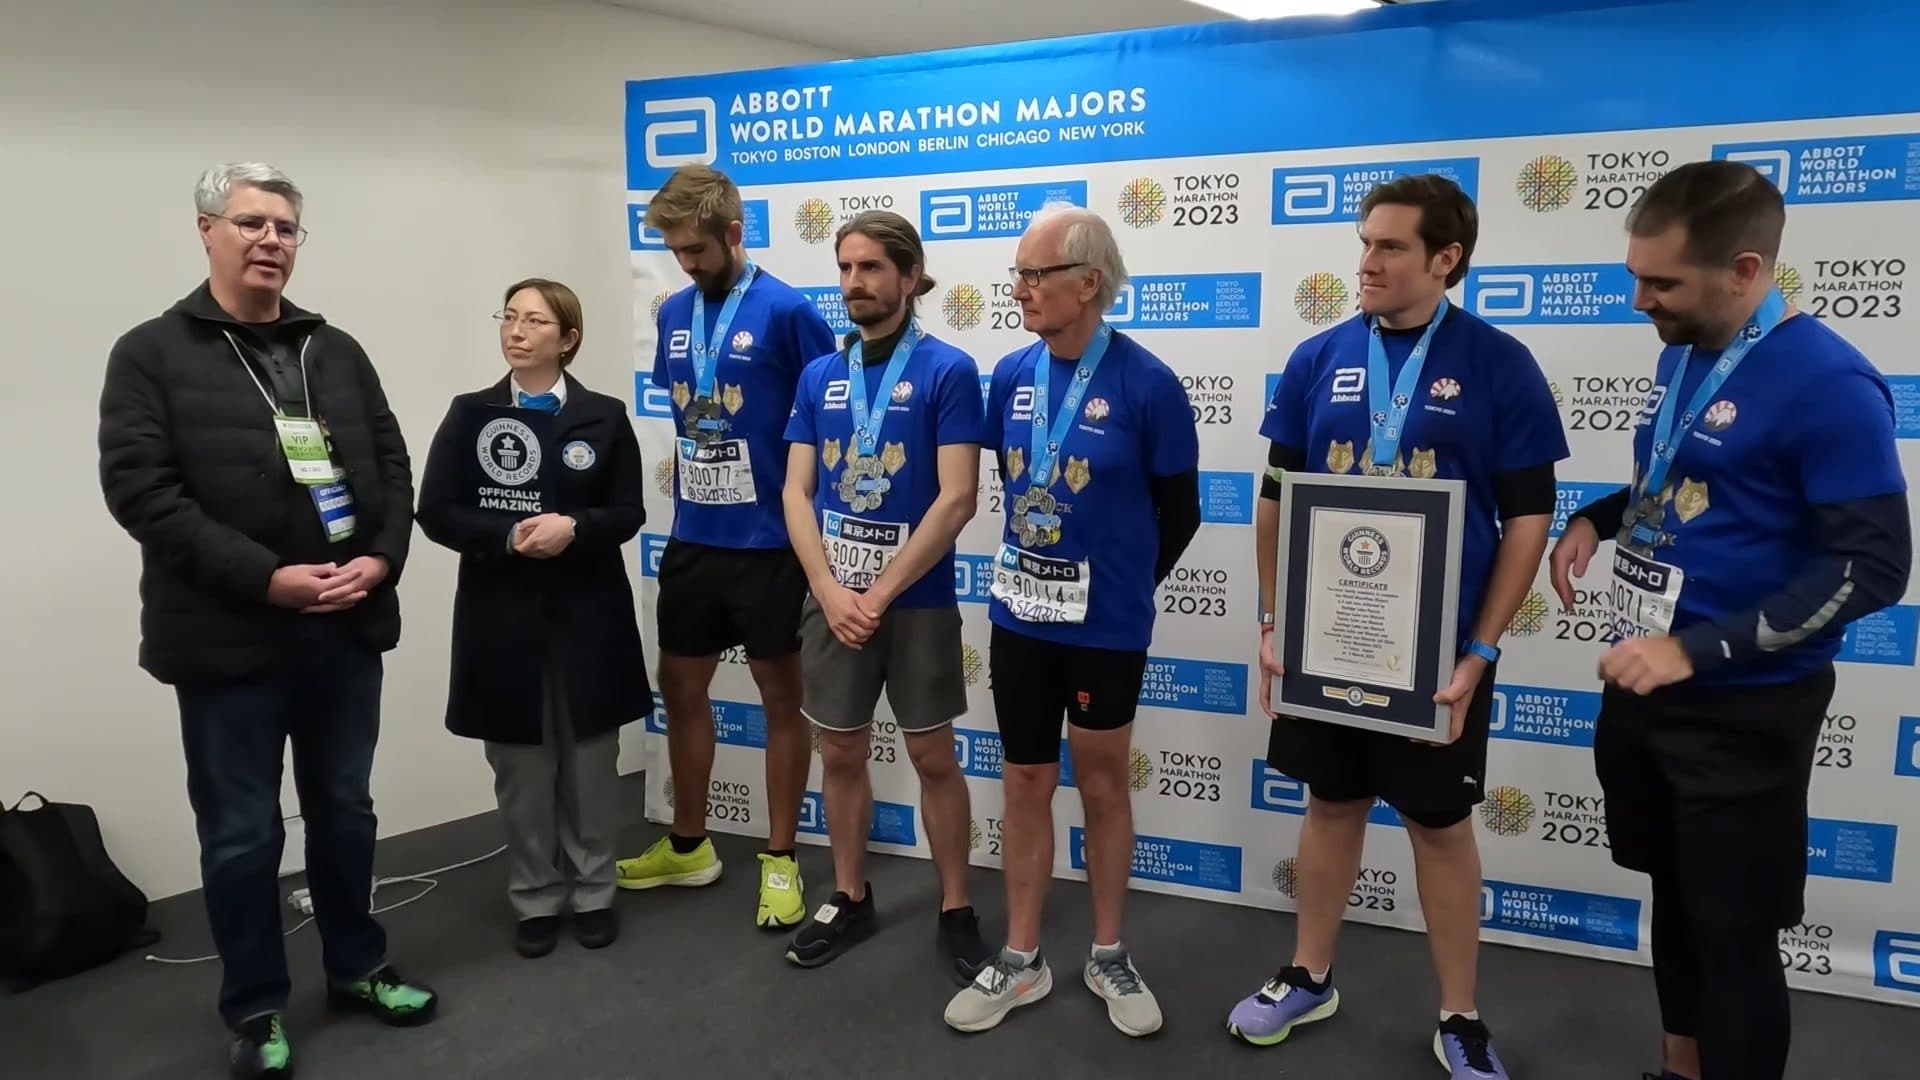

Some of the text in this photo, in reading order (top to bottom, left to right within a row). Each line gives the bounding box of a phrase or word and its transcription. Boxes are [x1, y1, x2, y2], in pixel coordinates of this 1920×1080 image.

[729, 85, 832, 116] ABBOTT
[730, 87, 1146, 145] WORLD MARATHON MAJORS
[731, 121, 1145, 165] TOKYO BOSTON LONDON BERLIN CHICAGO NEW YORK
[1800, 145, 1866, 160] ABBOTT
[1587, 150, 1669, 170] TOKYO
[1800, 158, 1859, 171] WORLD
[1173, 173, 1240, 191] TOKYO
[1344, 170, 1395, 183] ABBOTT
[1799, 168, 1897, 184] MARATHON
[1797, 182, 1867, 196] MAJORS
[840, 194, 894, 211] TOKYO
[978, 191, 1019, 203] ABBOTT
[1173, 192, 1239, 204] MARATHON
[1584, 186, 1650, 210] 202
[978, 202, 1016, 212] WORLD
[1173, 204, 1240, 227] 2023
[978, 220, 1022, 232] MAJORS
[1814, 258, 1906, 278] TOKYO
[1542, 272, 1599, 283] ABBOTT
[1141, 282, 1187, 293] ABBOTT
[1542, 283, 1593, 294] WORLD
[1813, 279, 1903, 292] MARATHON
[817, 293, 843, 302] ABBO
[1141, 291, 1183, 302] WORLD
[1541, 293, 1626, 305] MARATHON
[1140, 301, 1209, 312] MARATHON
[1216, 300, 1240, 308] BERLIN
[1540, 305, 1601, 317] MAJORS
[1811, 294, 1901, 319] 2023
[1140, 311, 1189, 322] MAJORS
[1180, 375, 1233, 391] OKYO
[1572, 377, 1652, 393] TOKYO
[1187, 393, 1232, 403] RATHON
[485, 423, 532, 442] GUINNESS
[291, 435, 309, 445] VIP
[481, 446, 503, 478] WORLD
[505, 449, 538, 481] RECORDS
[688, 465, 731, 487] 90077
[478, 486, 541, 500] OFFICIALLY
[1556, 490, 1584, 500] OTT
[479, 497, 542, 512] AMAZING
[842, 522, 896, 541] 東京メトロ
[1347, 529, 1384, 545] GUINNESS
[832, 541, 884, 572] 90079
[1022, 557, 1076, 578] 東京メトロ
[1013, 574, 1066, 607] 90114
[1164, 583, 1226, 596] MARATHON
[1338, 578, 1389, 591] CERTIFICATE
[1163, 595, 1226, 617] 2023
[1142, 672, 1173, 682] ORLD
[1141, 682, 1198, 694] ARATHON
[1139, 691, 1179, 702] AJORS
[1515, 693, 1568, 707] ABBOTT
[1514, 703, 1563, 716] WORLD
[1514, 713, 1595, 729] MARATHON
[1513, 724, 1570, 737] MAJORS
[974, 737, 1002, 747] ABBO
[974, 746, 1003, 756] WORL
[1160, 750, 1222, 770] TOKYO
[1159, 767, 1221, 781] MARATHON
[711, 780, 750, 796] OKYO
[1159, 778, 1221, 801] 2023
[1544, 791, 1603, 812] TOKY
[1502, 890, 1553, 902] ABBOTT
[1501, 899, 1549, 911] WORLD
[1501, 909, 1579, 926] MARATHON
